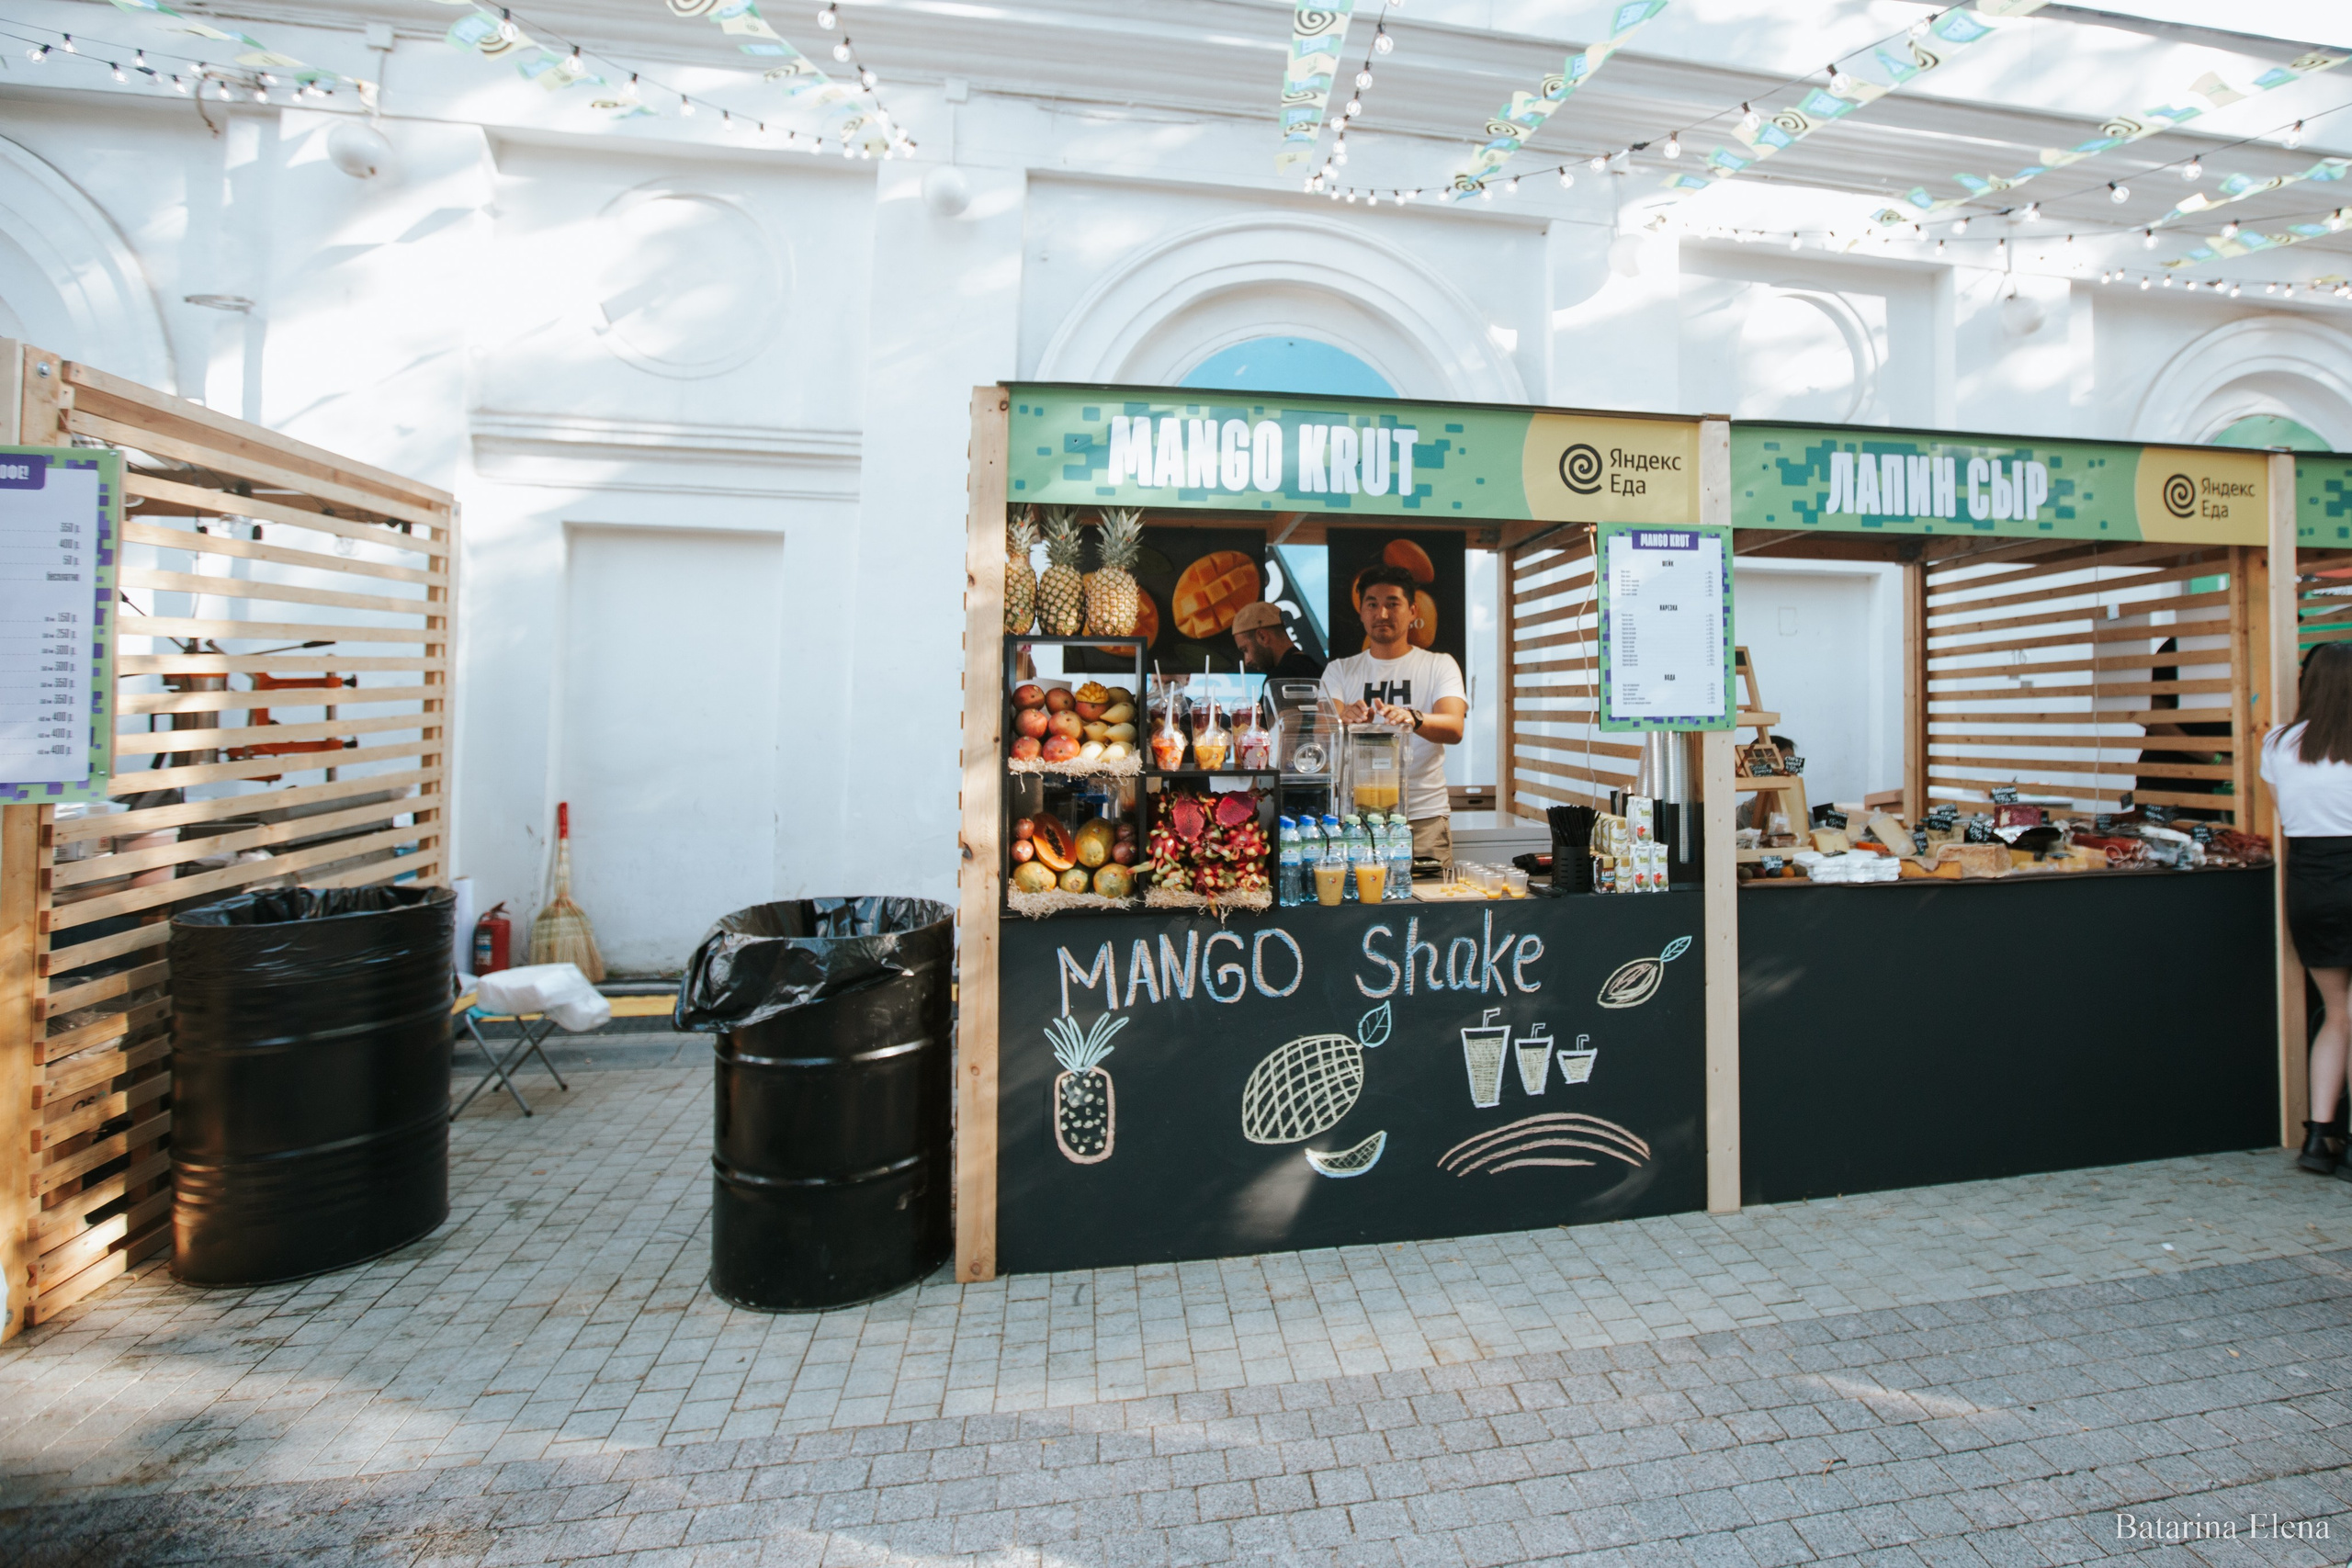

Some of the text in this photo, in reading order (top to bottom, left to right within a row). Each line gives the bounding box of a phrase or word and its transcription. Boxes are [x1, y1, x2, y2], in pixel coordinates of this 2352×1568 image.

[1108, 415, 1418, 496] MANGO KRUT
[1610, 448, 1681, 472] Яндекс
[1611, 473, 1646, 497] Еда
[1826, 451, 2048, 521] ЛАПИН СЫР
[2201, 478, 2256, 498] Яндекс
[2202, 500, 2229, 520] Еда
[1640, 533, 1690, 547] MANGO KRUT
[1363, 680, 1412, 708] HH
[1057, 908, 1545, 1018] MANGO Shake
